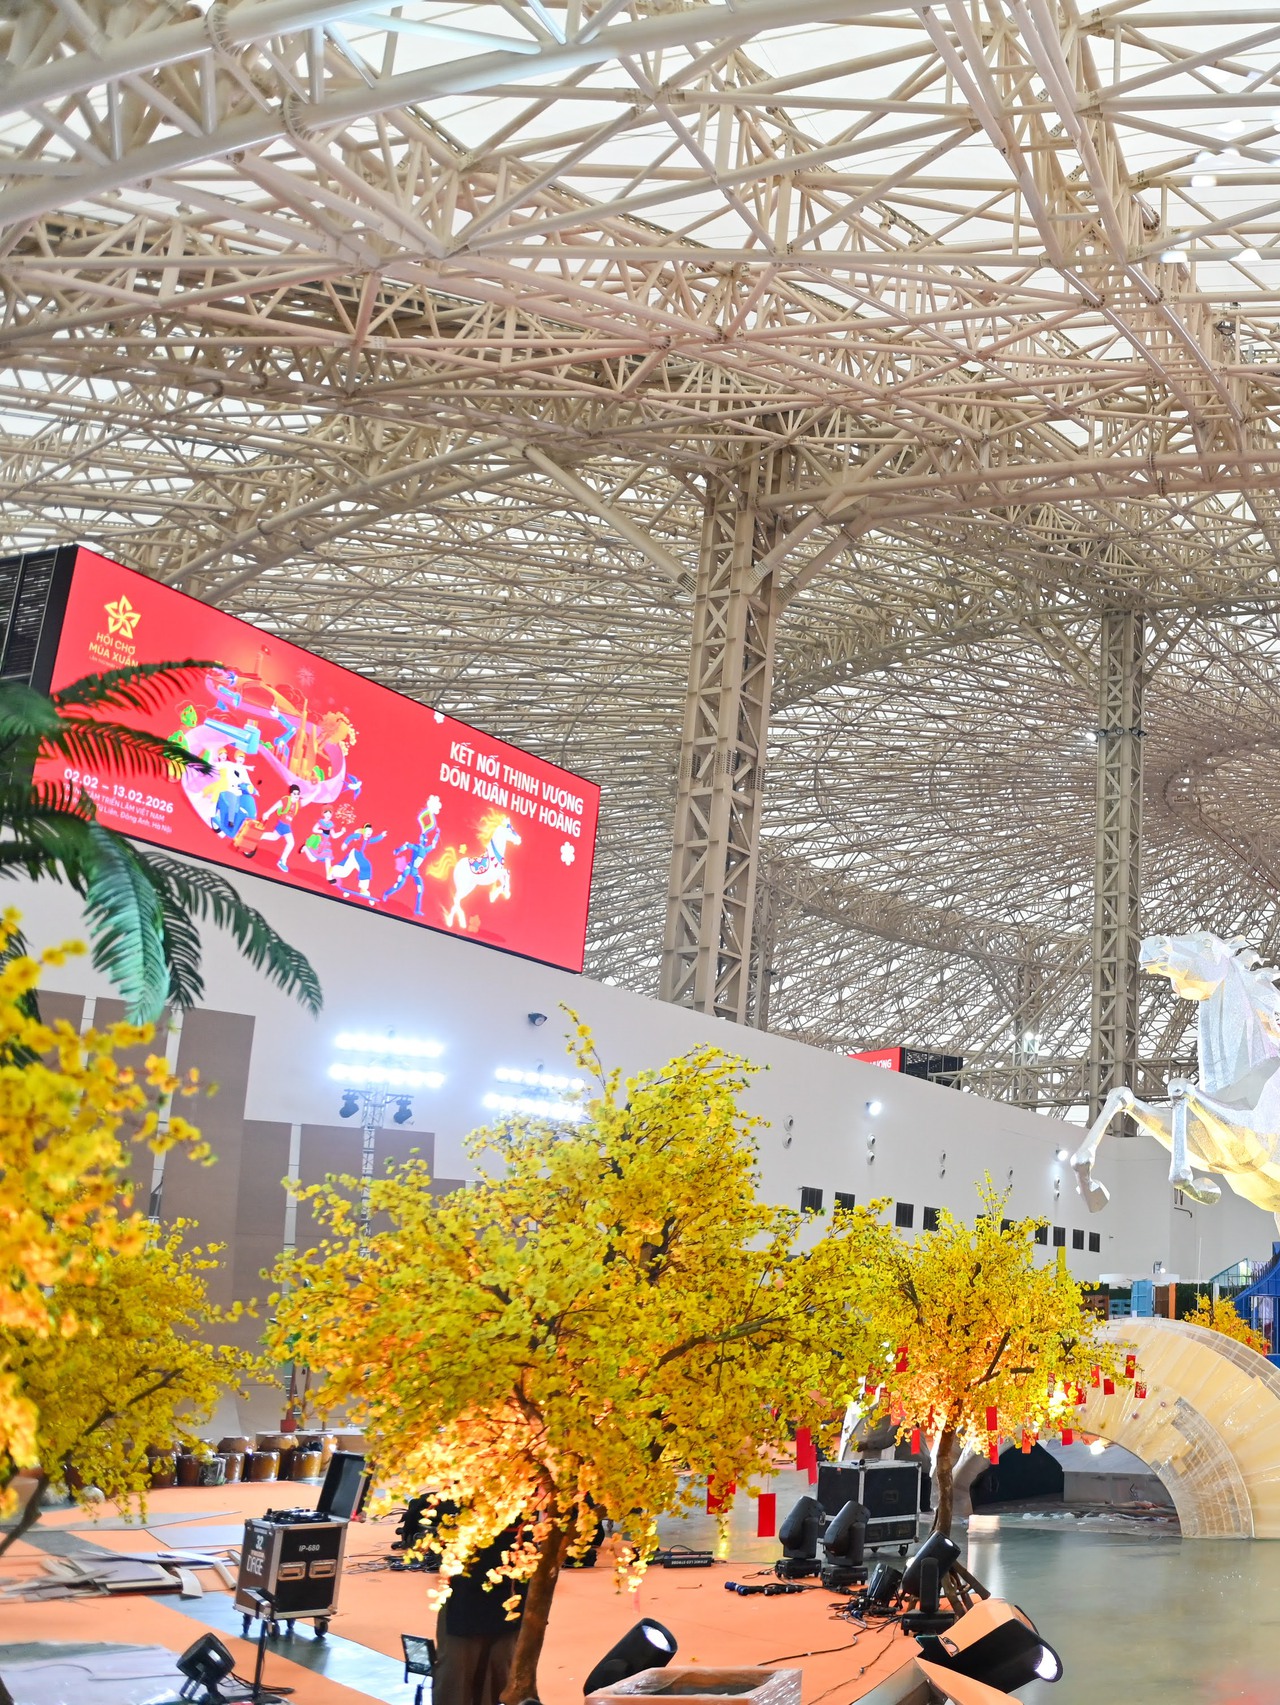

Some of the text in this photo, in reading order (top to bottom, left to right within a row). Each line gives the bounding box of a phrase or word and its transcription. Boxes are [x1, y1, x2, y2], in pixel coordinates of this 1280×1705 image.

[88, 641, 110, 659] MÙA
[96, 632, 136, 656] HỘI CHỢ
[64, 768, 99, 789] 02.02
[113, 784, 174, 813] 13.02.2026
[450, 741, 584, 815] KẾT NỐI THỊNH VƯỢNG
[440, 762, 582, 838] ĐÓN XUÂN HUY HOÀNG
[298, 1544, 321, 1552] IP-680
